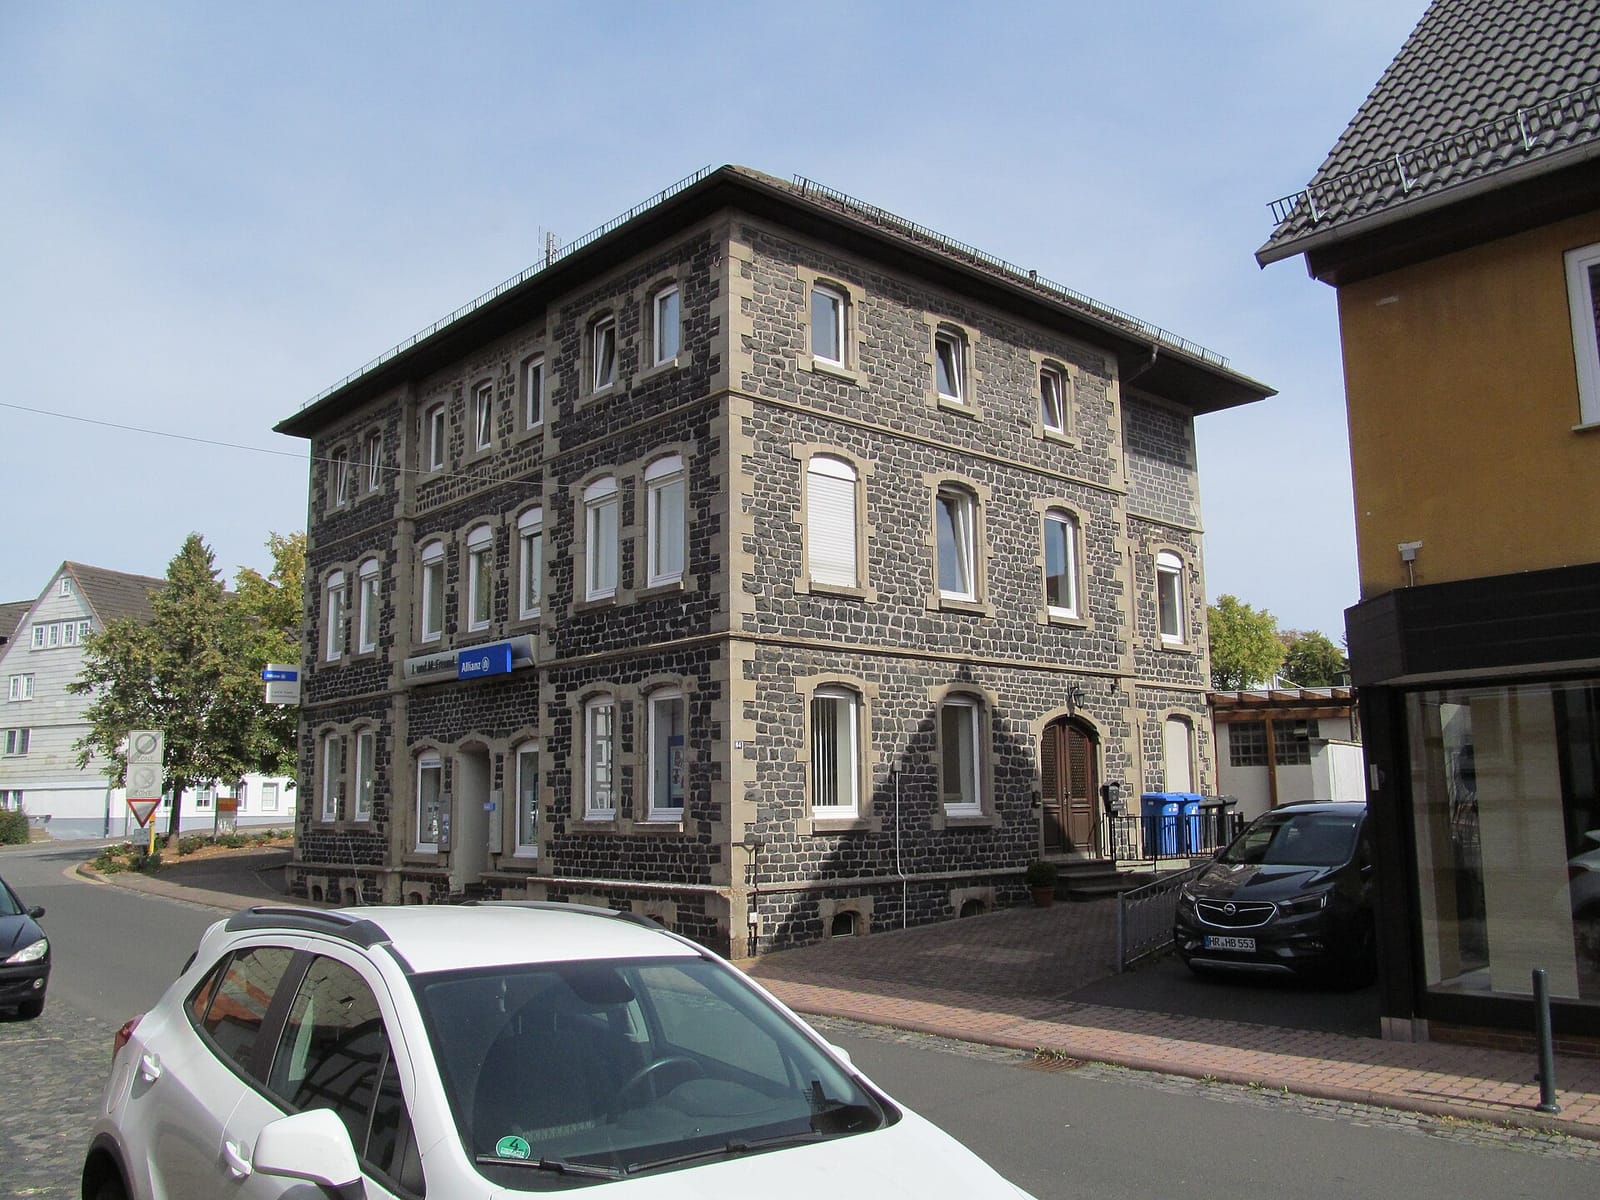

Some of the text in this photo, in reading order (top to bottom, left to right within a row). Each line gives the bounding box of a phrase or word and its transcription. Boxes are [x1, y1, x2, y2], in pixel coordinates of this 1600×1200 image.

[461, 660, 481, 673] Allianz
[1210, 937, 1255, 949] HR HB 553
[510, 1138, 519, 1151] 4
